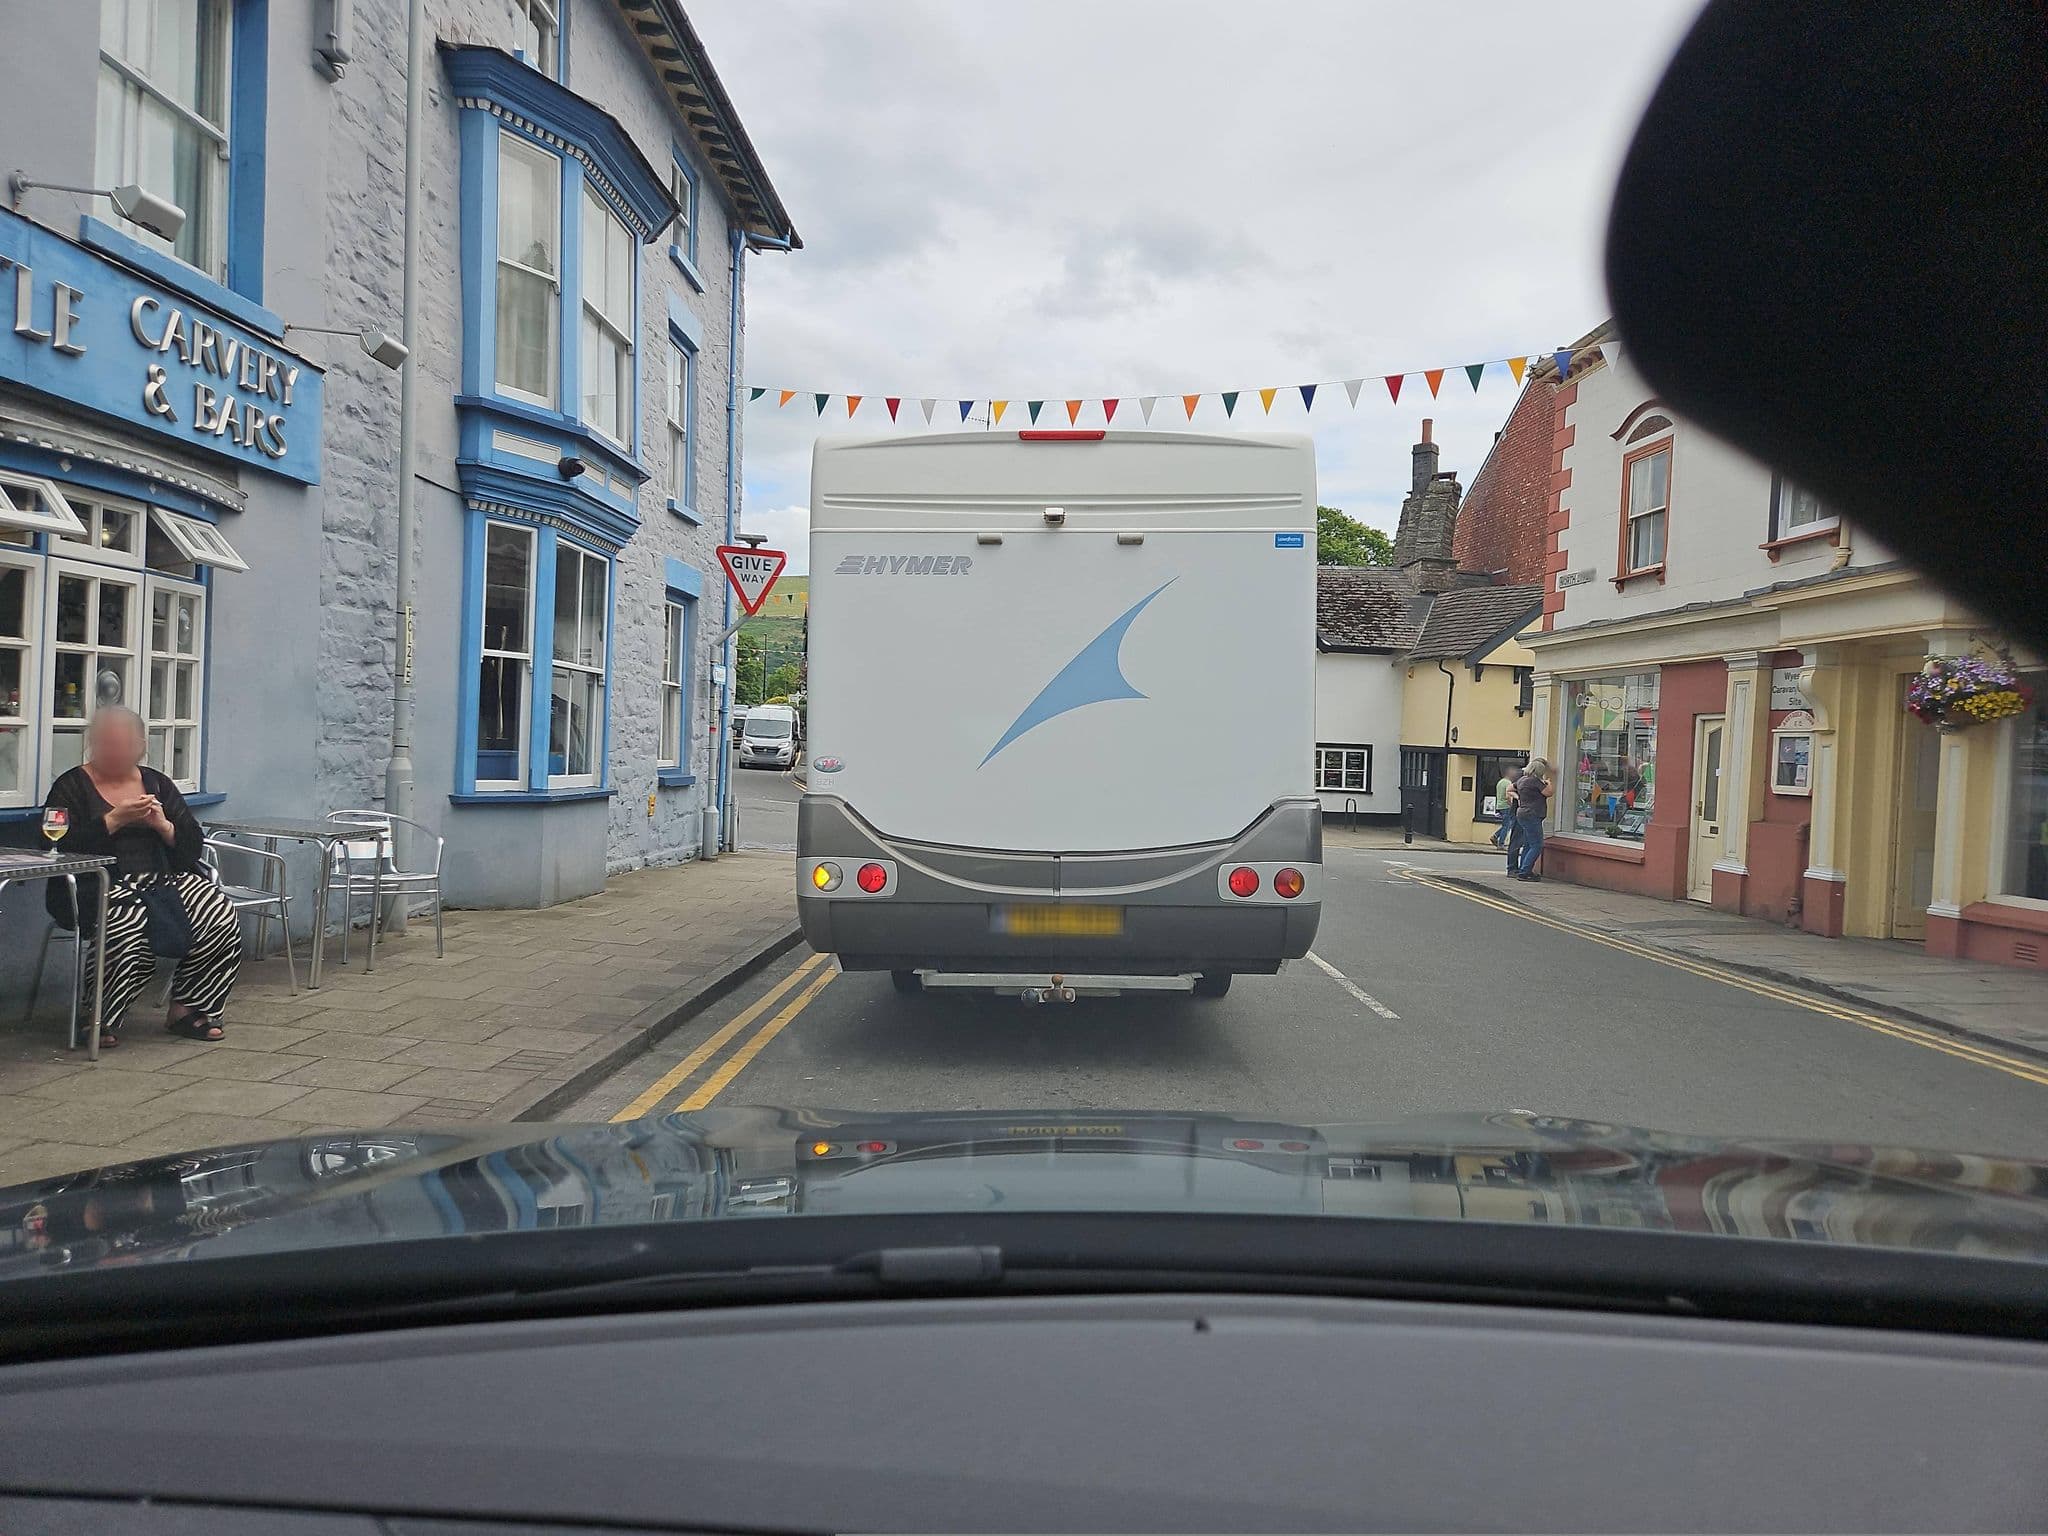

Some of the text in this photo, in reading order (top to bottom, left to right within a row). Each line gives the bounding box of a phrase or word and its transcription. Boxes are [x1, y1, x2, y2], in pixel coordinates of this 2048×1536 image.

[0, 255, 87, 356] LE
[130, 295, 300, 406] CARVERY
[144, 363, 288, 459] & BARS
[732, 556, 772, 572] GIVE
[863, 555, 973, 575] HYMER
[740, 573, 766, 584] WAY
[1788, 697, 1802, 706] Site
